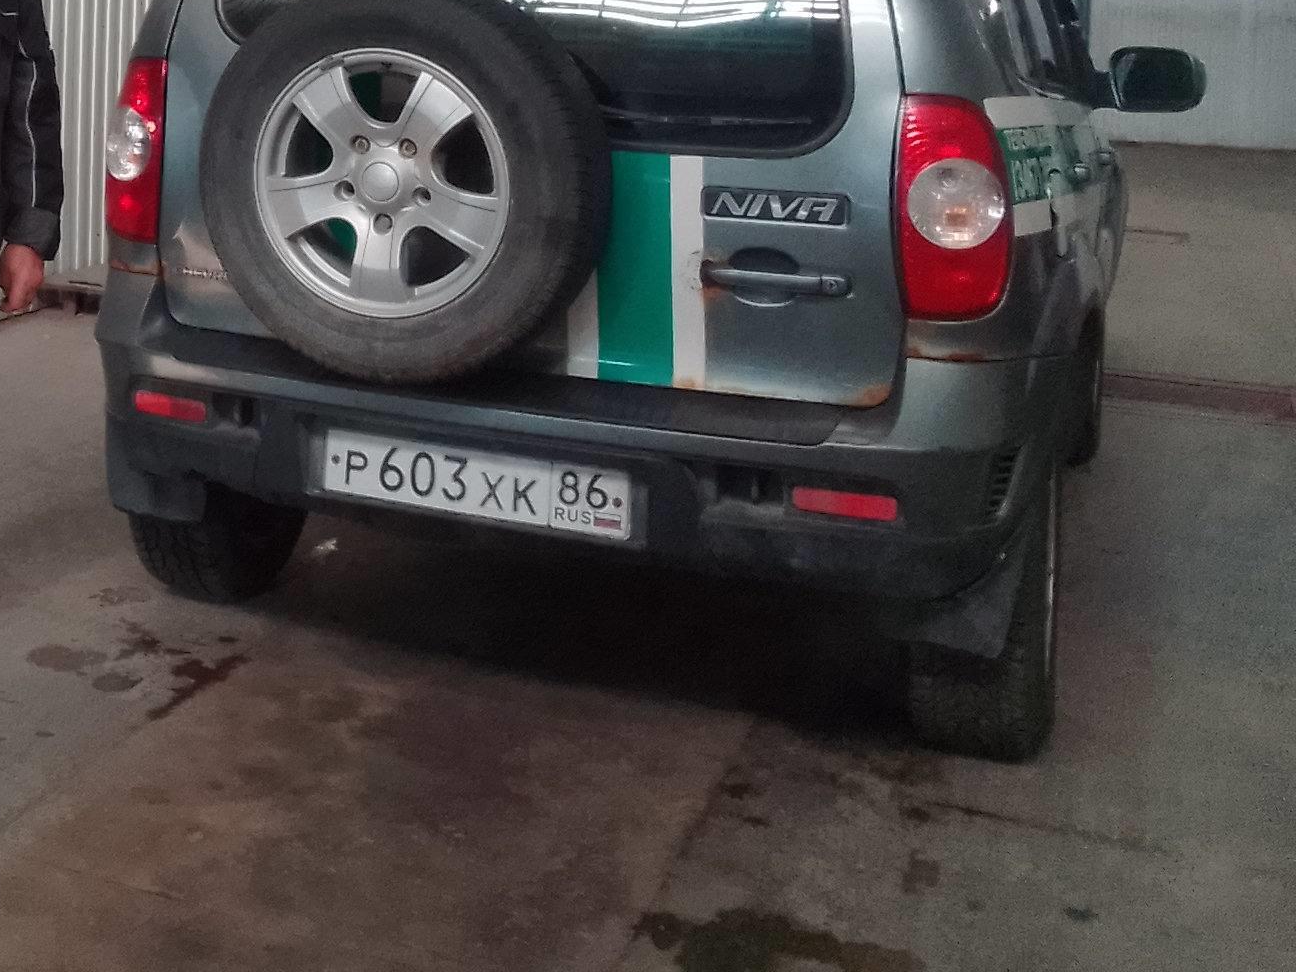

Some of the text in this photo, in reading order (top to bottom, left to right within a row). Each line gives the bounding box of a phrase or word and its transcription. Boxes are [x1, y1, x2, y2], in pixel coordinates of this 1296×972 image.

[711, 191, 838, 222] NIVA
[558, 470, 609, 510] 86
[554, 505, 593, 526] RUS
